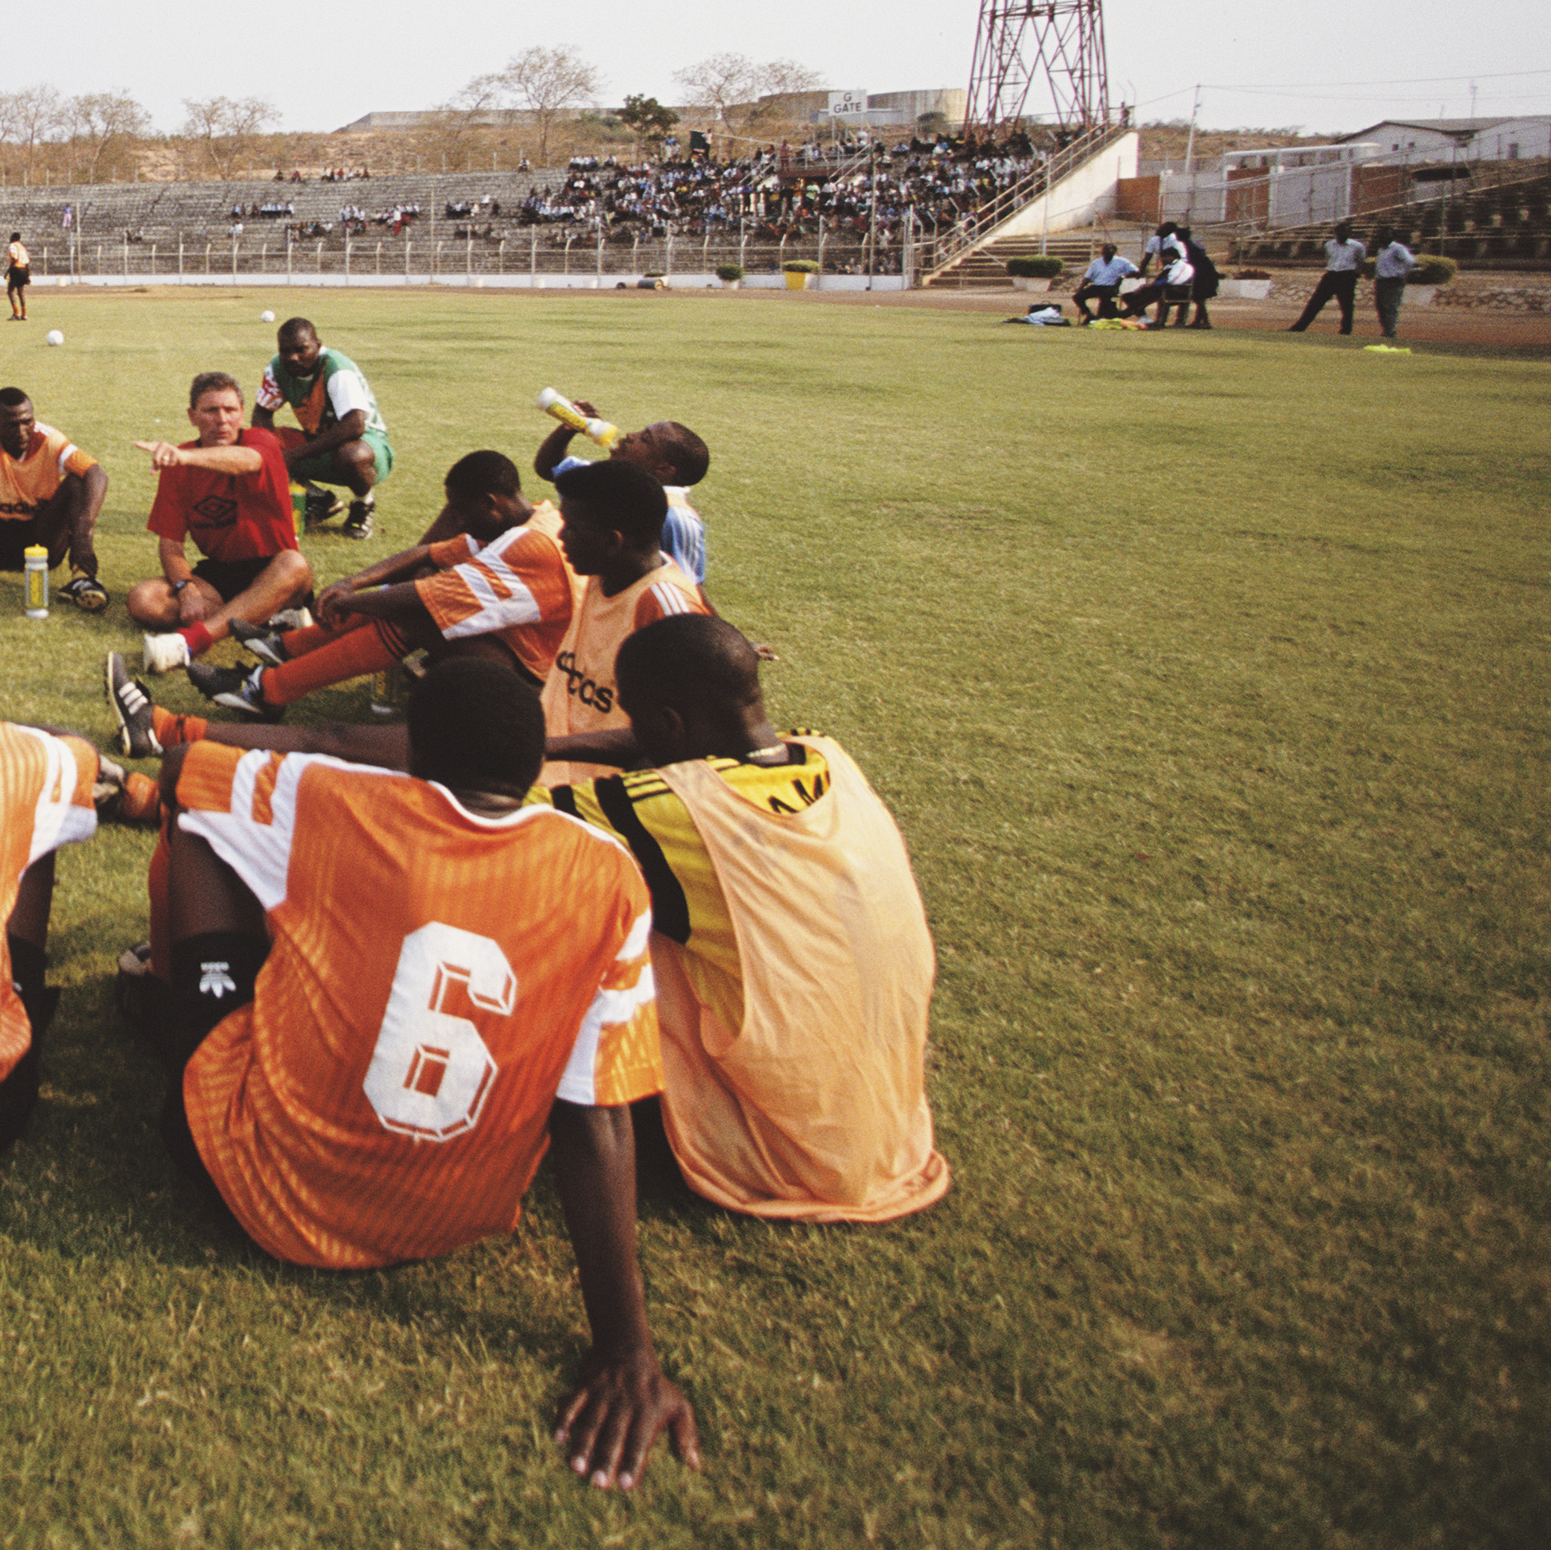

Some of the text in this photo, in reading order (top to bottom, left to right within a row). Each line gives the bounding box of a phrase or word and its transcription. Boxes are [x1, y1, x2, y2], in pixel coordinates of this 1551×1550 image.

[843, 92, 852, 102] G
[833, 102, 862, 114] GATE
[362, 920, 517, 1142] 6
